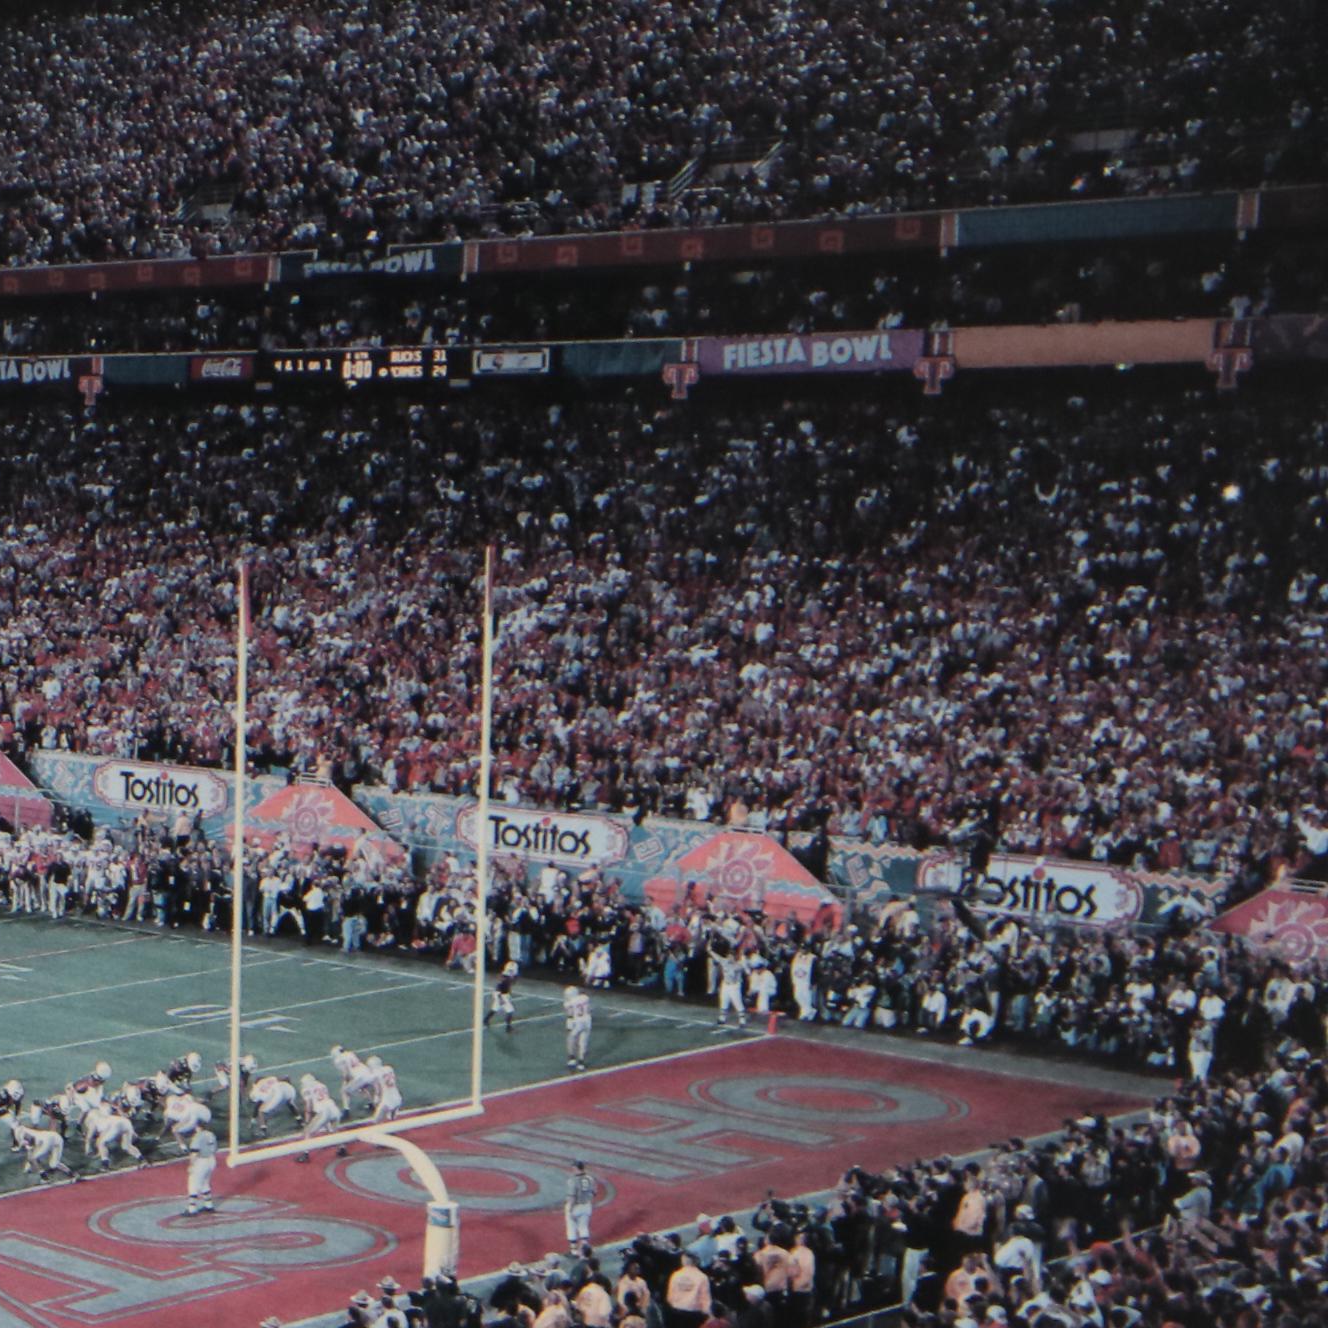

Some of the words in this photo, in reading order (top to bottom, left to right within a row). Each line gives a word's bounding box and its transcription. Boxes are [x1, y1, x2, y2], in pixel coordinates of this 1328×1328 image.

[23, 359, 70, 383] BOWL
[723, 339, 807, 371] FIESTA
[811, 336, 891, 368] BOWL
[120, 770, 199, 807] Tostitos
[489, 814, 591, 856] Tostitos
